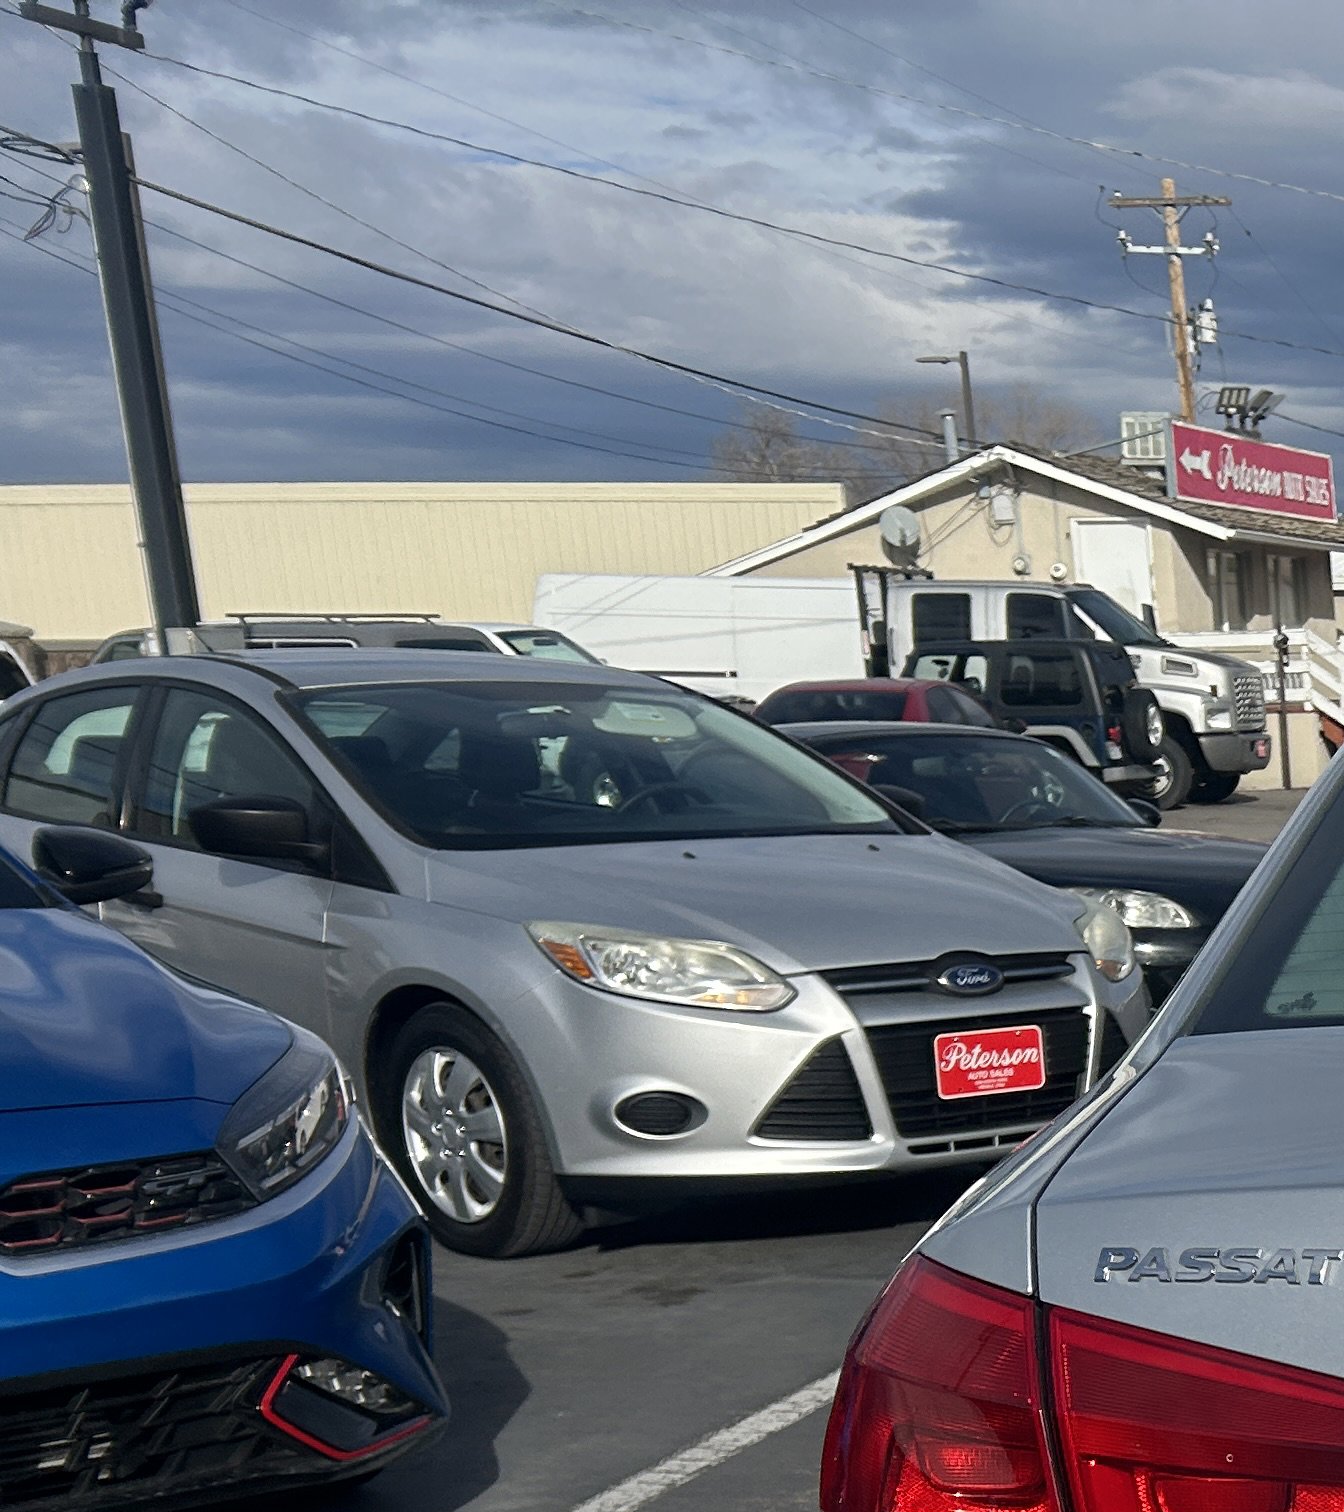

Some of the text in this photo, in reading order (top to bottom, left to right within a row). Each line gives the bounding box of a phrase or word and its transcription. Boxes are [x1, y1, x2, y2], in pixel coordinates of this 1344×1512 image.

[957, 968, 990, 985] Ford
[941, 1042, 1039, 1072] Peterson
[1094, 1247, 1344, 1285] PASSAT
